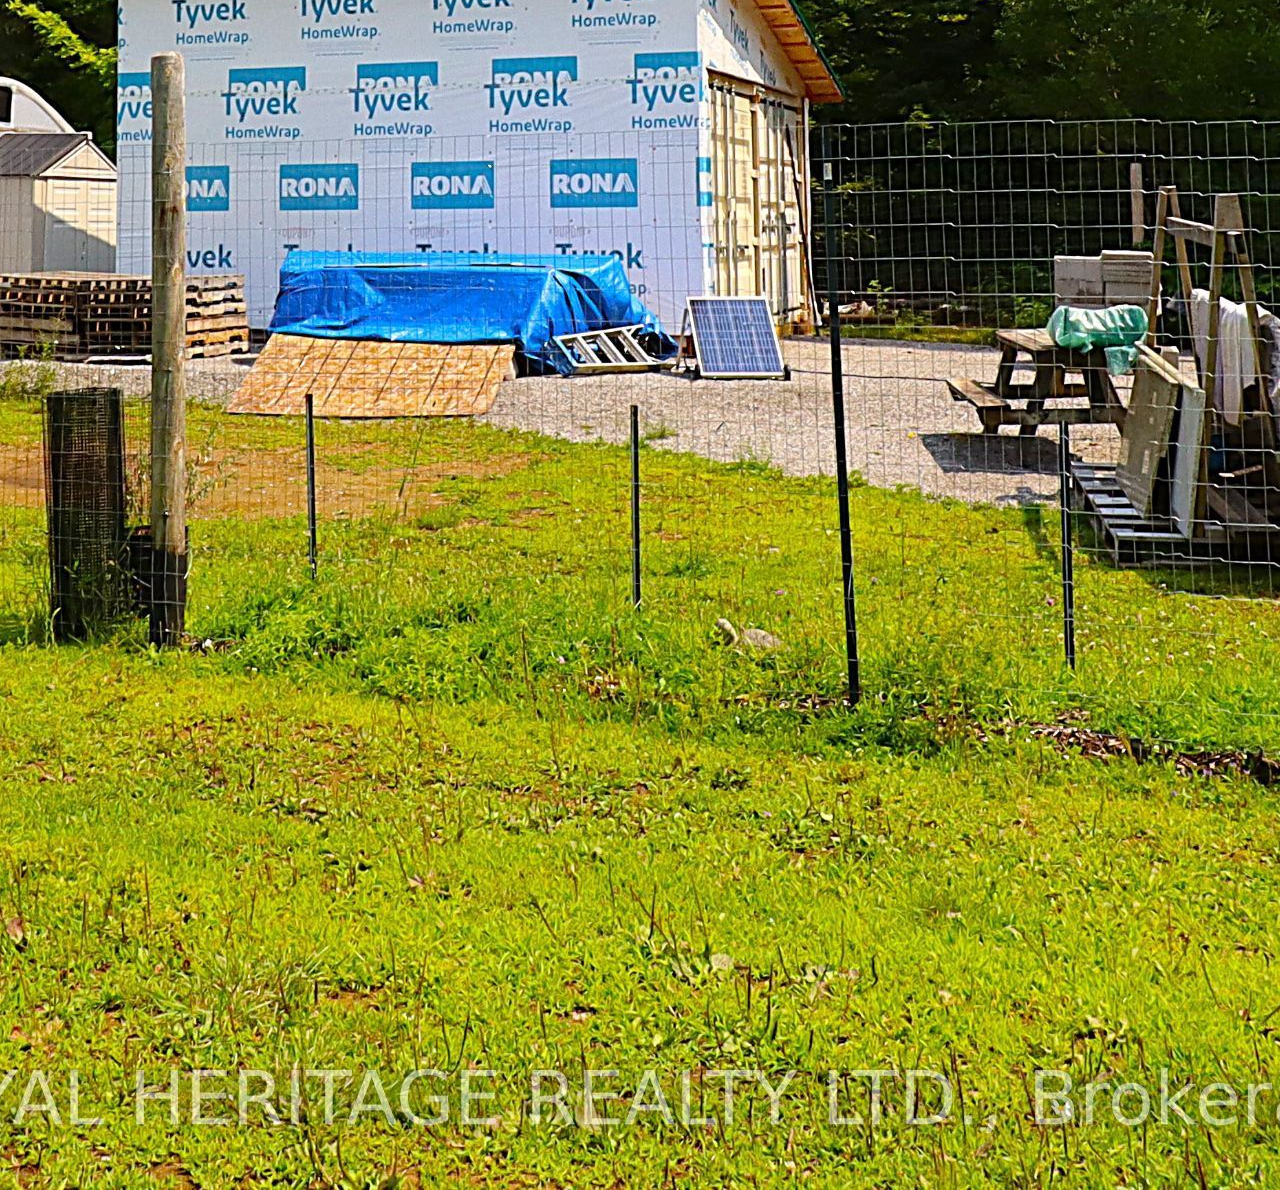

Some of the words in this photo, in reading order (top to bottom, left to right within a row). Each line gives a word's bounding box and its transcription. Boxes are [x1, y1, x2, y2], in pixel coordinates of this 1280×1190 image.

[433, 19, 514, 34] HomeWrap
[572, 12, 657, 27] HomeWrap
[176, 31, 250, 46] HomeWrap
[301, 25, 378, 40] HomeWrap
[636, 66, 698, 81] RON
[350, 84, 430, 119] Tyvek
[484, 79, 569, 114] Tyvek
[222, 88, 298, 122] Tyvek
[354, 122, 432, 137] HomeWrap
[489, 118, 572, 133] HomeWrap
[632, 115, 710, 129] HomeWr
[225, 125, 300, 140] HomeWrap
[281, 177, 357, 197] RONA
[412, 175, 492, 196] RONA
[551, 172, 636, 194] RONA
[186, 244, 232, 268] vek
